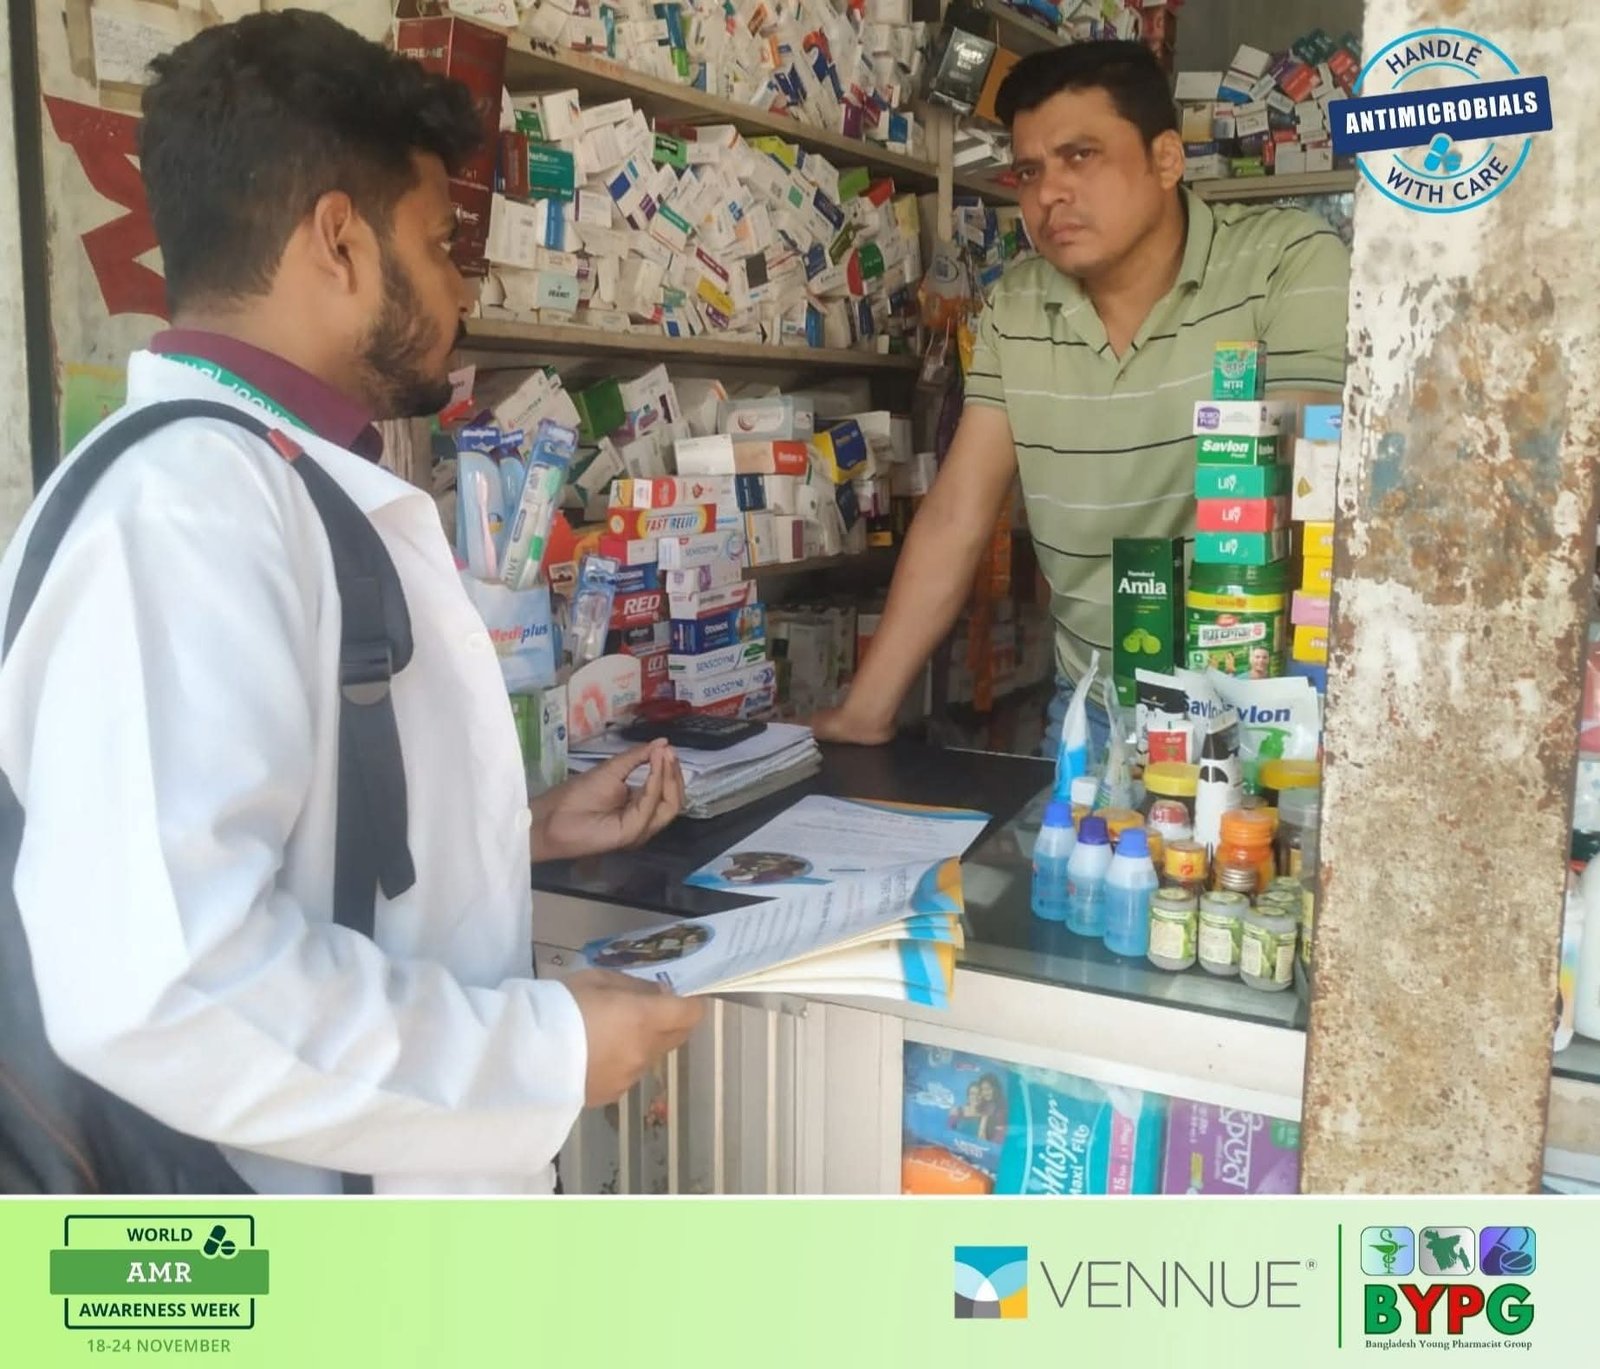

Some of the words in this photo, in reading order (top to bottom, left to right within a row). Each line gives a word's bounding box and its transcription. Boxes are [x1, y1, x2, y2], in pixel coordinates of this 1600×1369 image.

[1202, 440, 1249, 453] Savlon
[1118, 577, 1167, 595] Amla
[624, 594, 661, 615] RED
